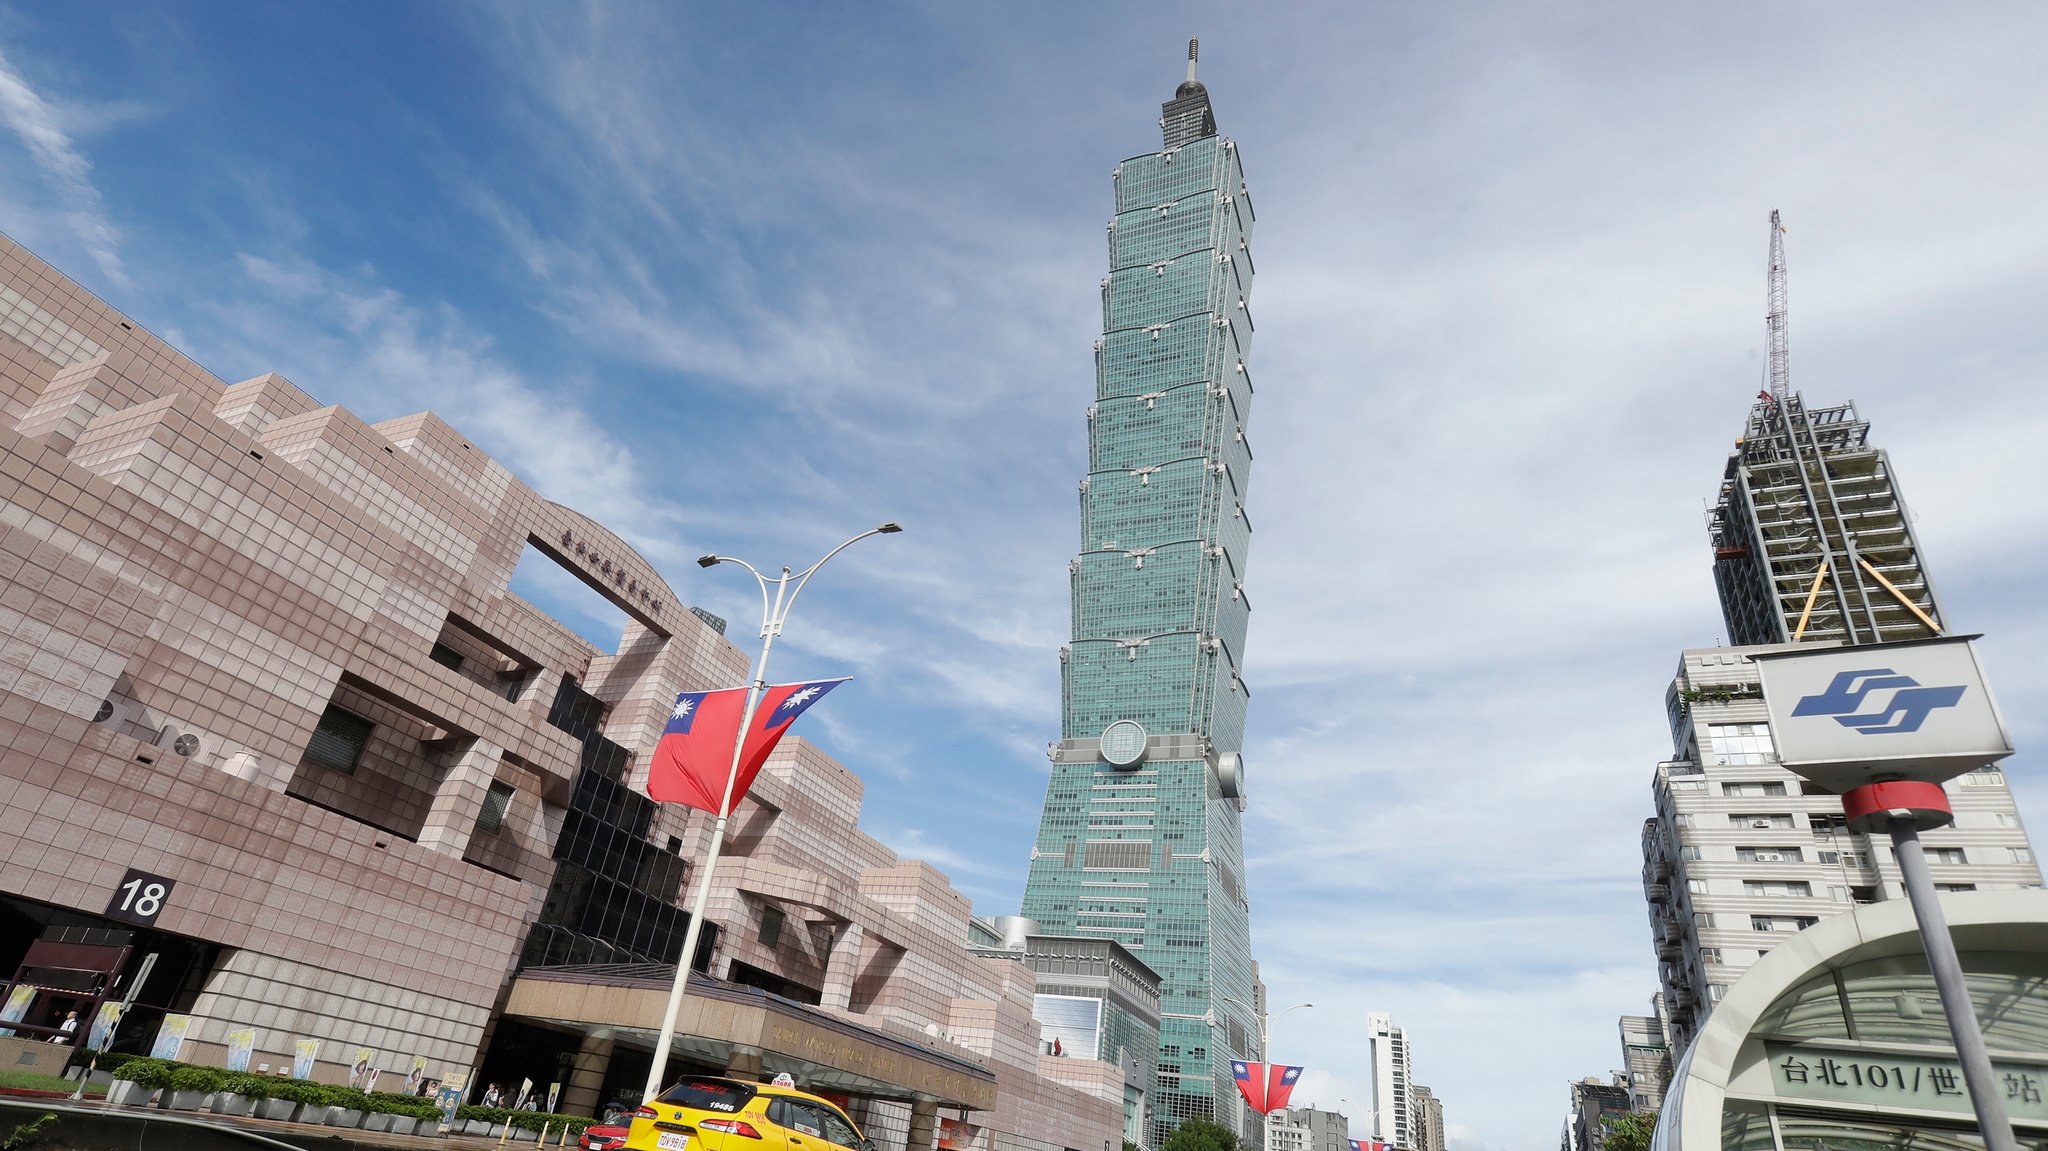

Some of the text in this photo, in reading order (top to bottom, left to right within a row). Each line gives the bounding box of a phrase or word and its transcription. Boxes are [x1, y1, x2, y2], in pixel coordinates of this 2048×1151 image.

[120, 878, 165, 916] 18
[1781, 1056, 2042, 1103] 台北101/世站
[709, 1101, 734, 1112] 19486
